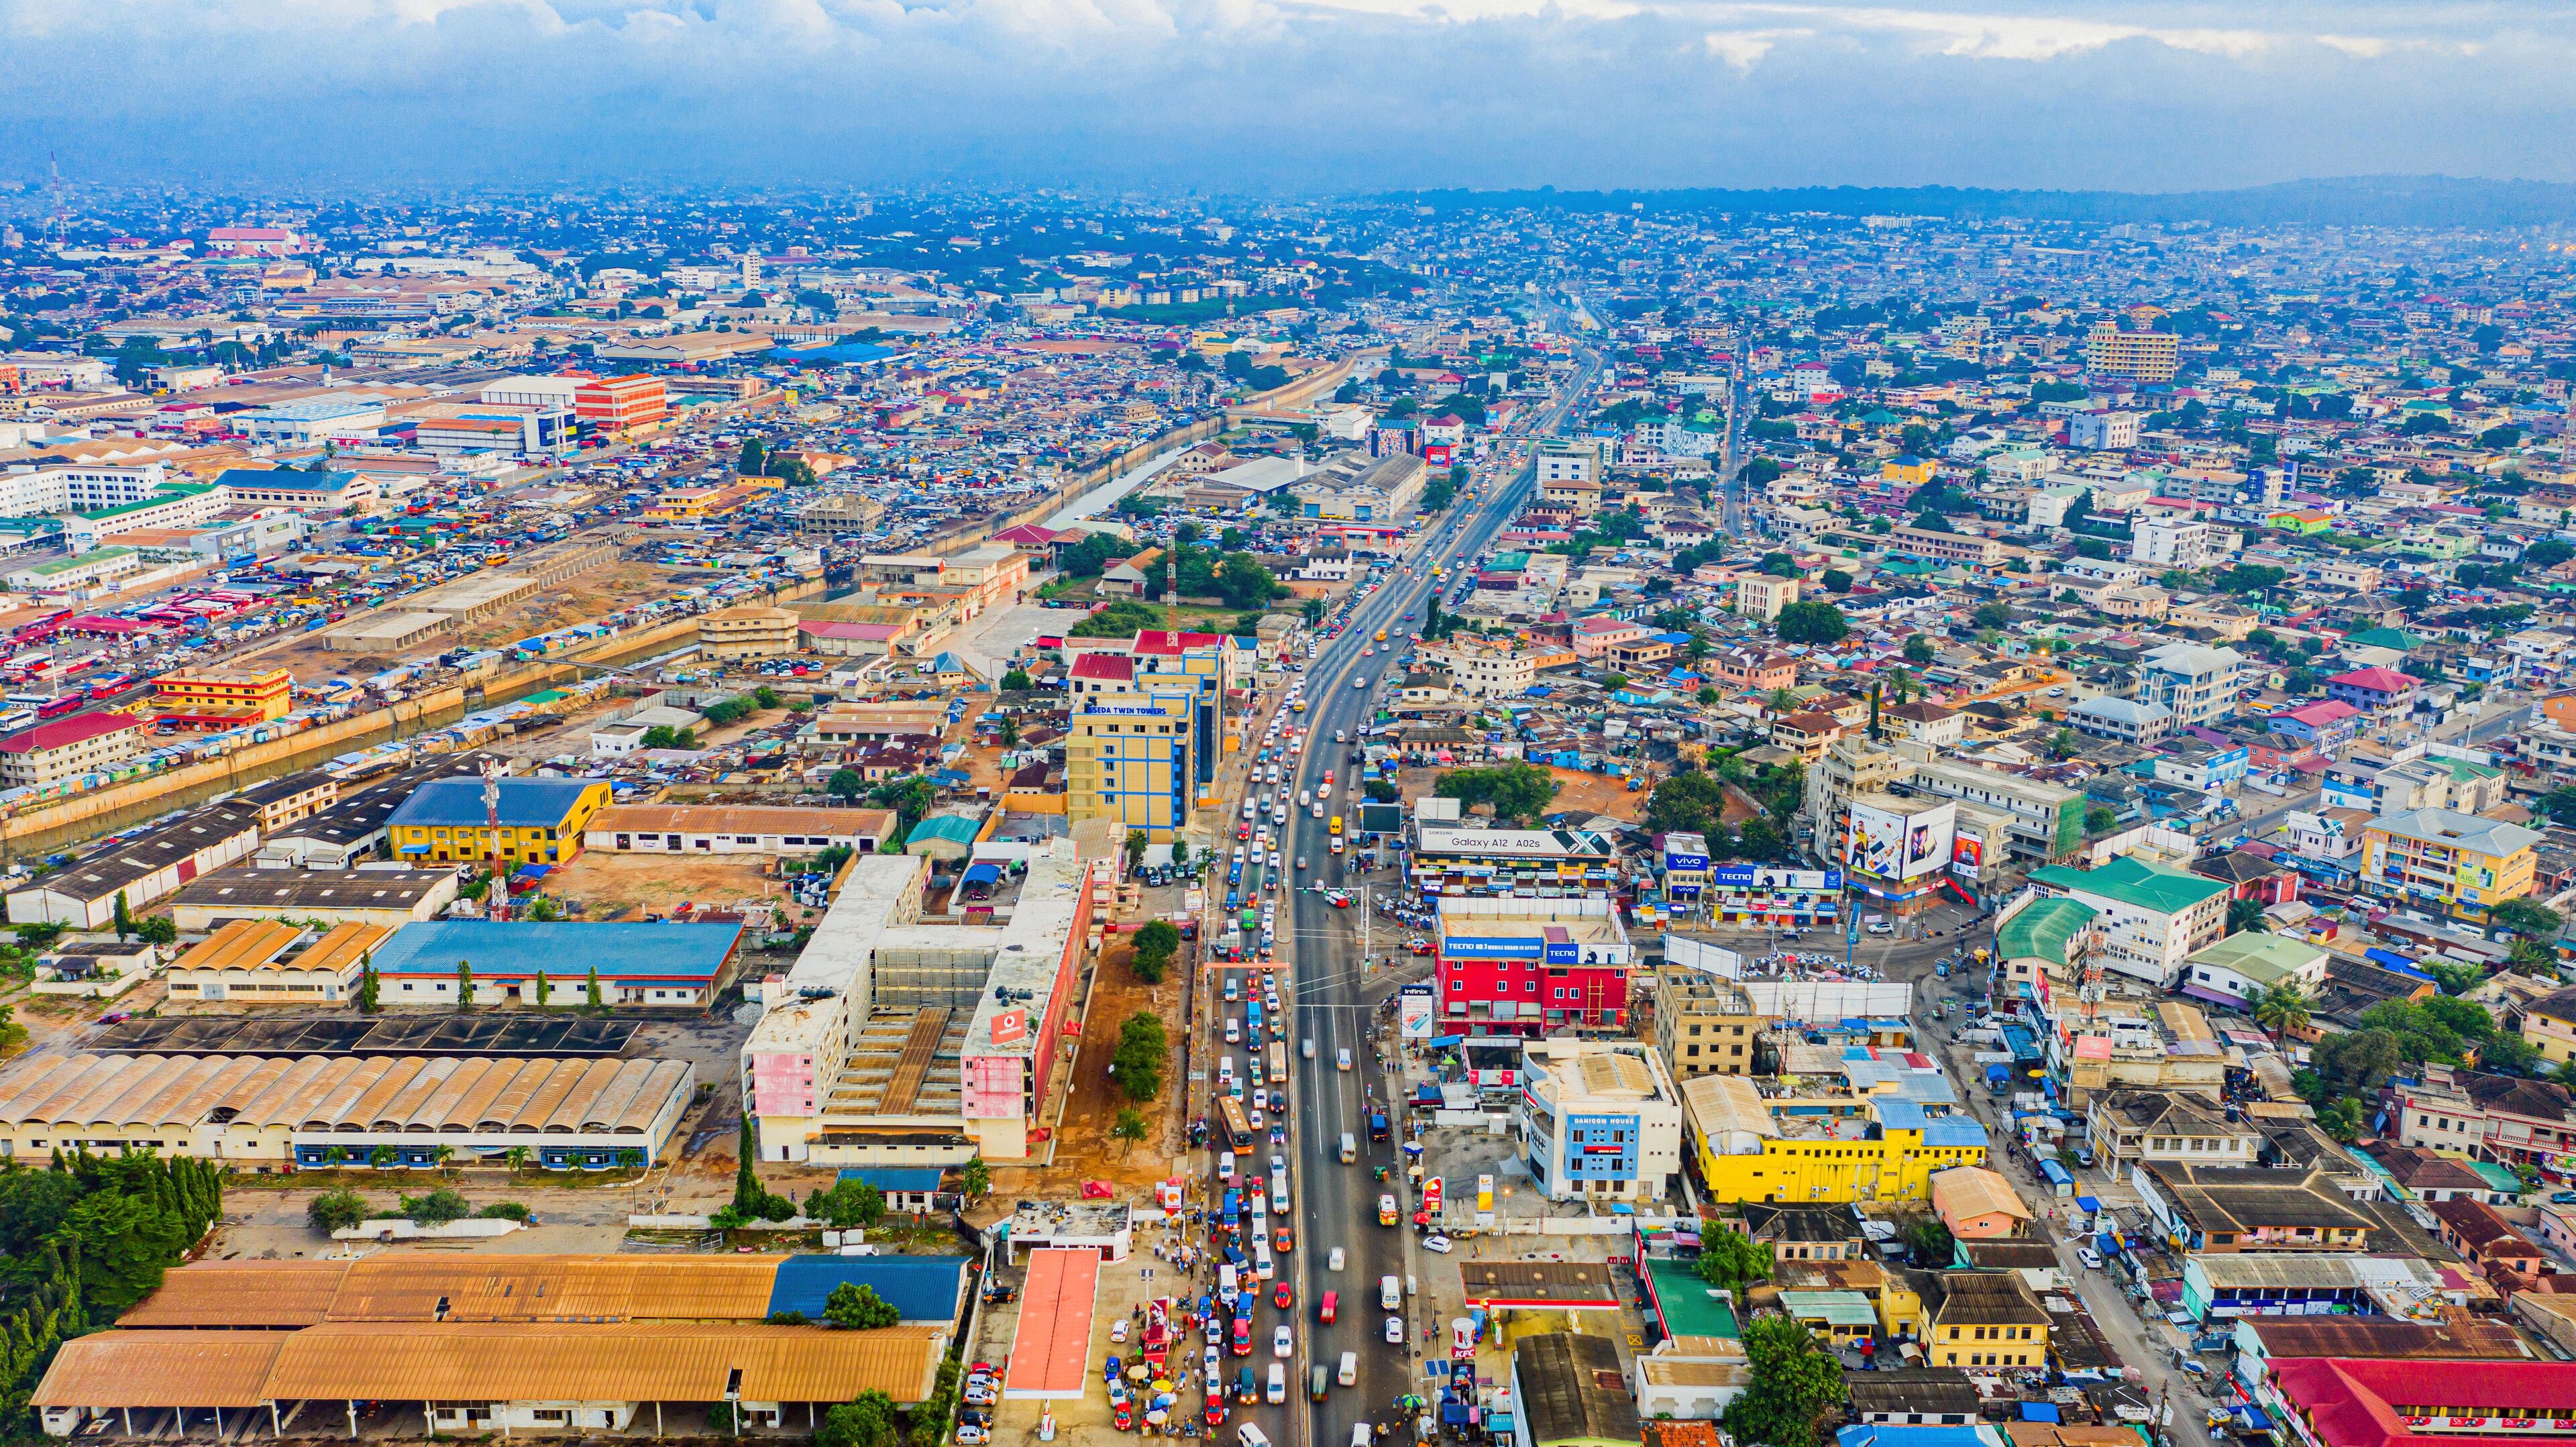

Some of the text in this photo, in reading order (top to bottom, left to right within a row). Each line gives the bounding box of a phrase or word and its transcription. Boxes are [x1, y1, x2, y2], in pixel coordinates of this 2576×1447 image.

[1853, 810, 1872, 821] Galaxy
[1452, 838, 1540, 849] Galaxy A12 A02s
[998, 1026, 1022, 1035] vodafone
[1454, 1349, 1474, 1358] KFC
